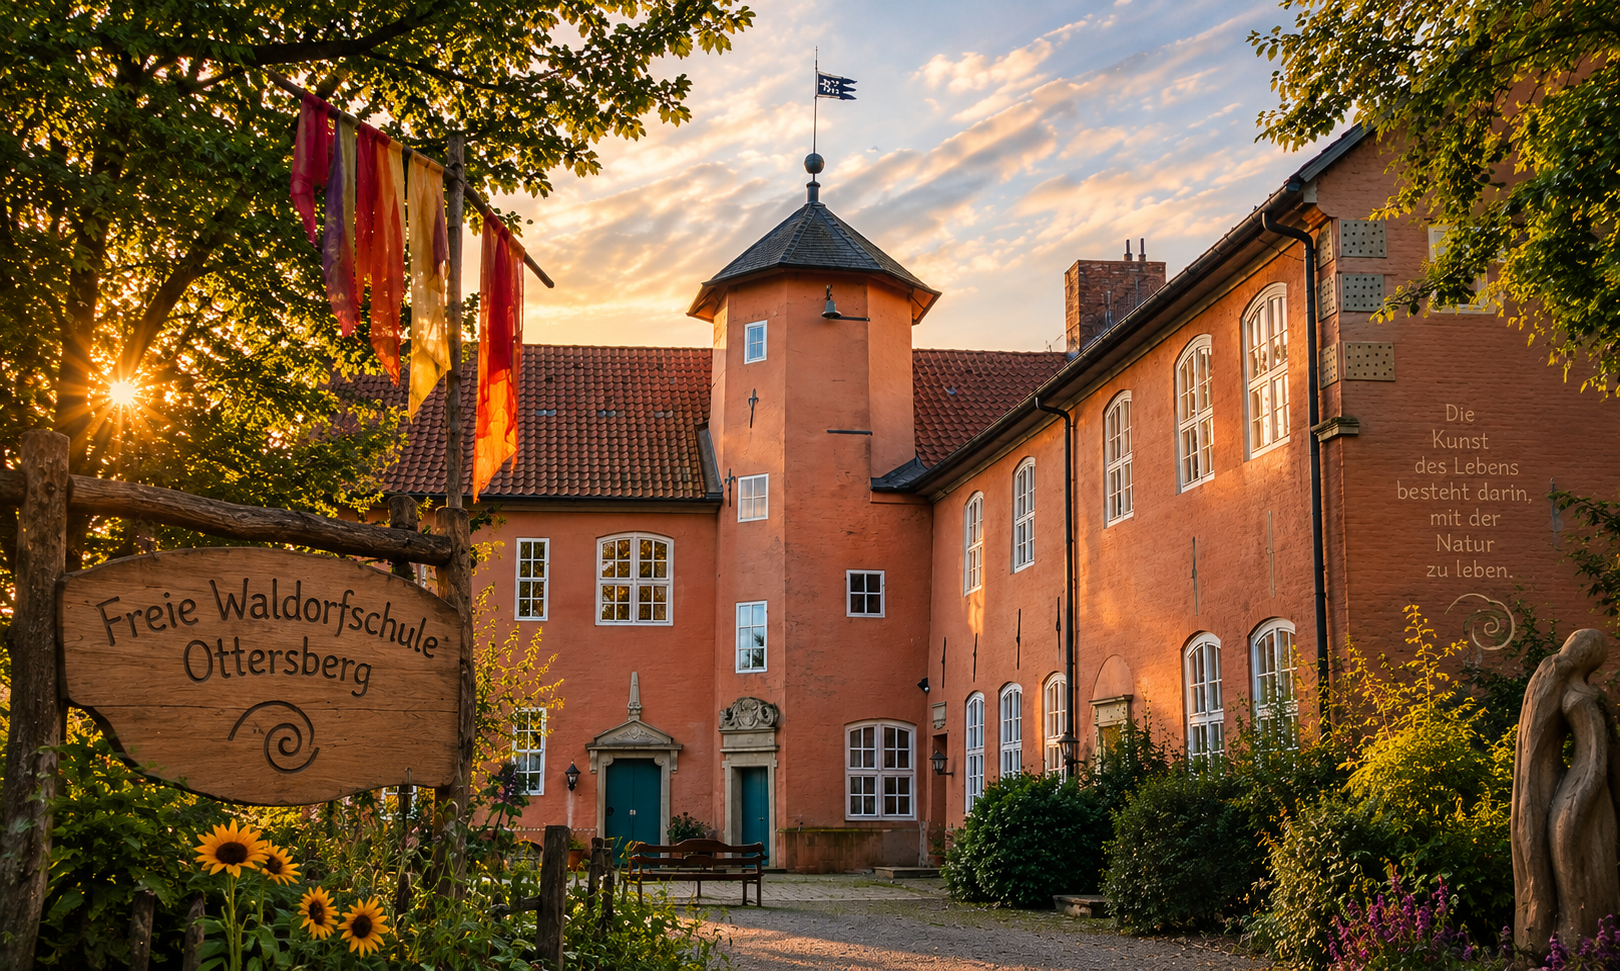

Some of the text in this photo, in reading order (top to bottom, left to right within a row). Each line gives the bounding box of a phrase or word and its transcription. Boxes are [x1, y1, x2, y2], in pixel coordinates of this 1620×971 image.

[1446, 403, 1475, 422] Die
[1432, 429, 1489, 450] Kunst
[1415, 456, 1519, 476] des Lebens
[1397, 480, 1532, 504] besteht darin,
[1430, 508, 1501, 527] mit der
[1436, 534, 1495, 552] Natur
[1426, 559, 1513, 579] zu leben.
[97, 577, 438, 658] Freie Waldorfschule
[183, 636, 372, 697] Ottersberg
